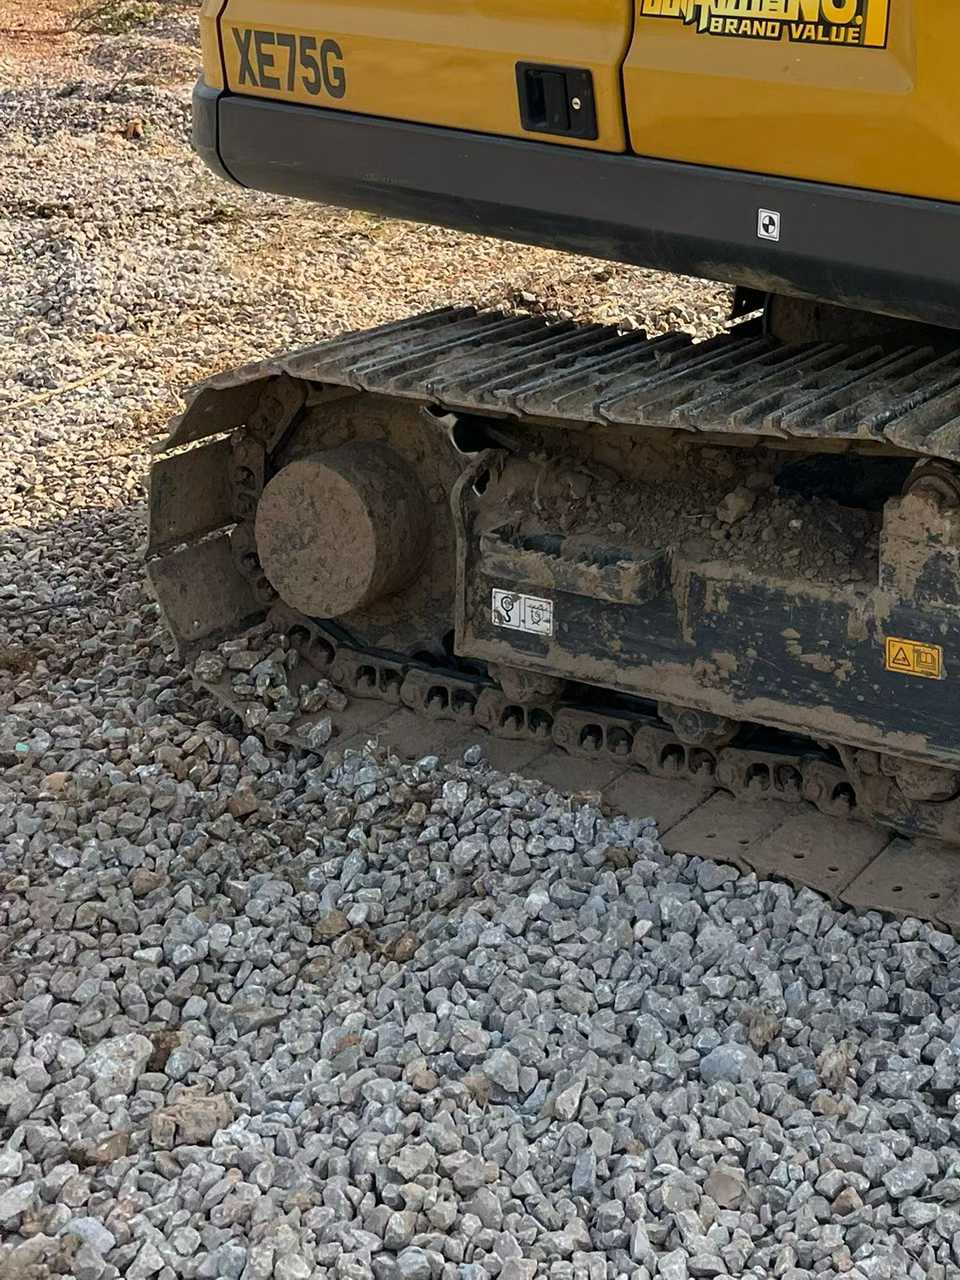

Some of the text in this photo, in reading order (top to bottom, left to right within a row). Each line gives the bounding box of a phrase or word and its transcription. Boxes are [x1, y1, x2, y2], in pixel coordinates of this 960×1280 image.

[709, 17, 862, 45] BRAND VALUE
[233, 27, 346, 99] XE75G
